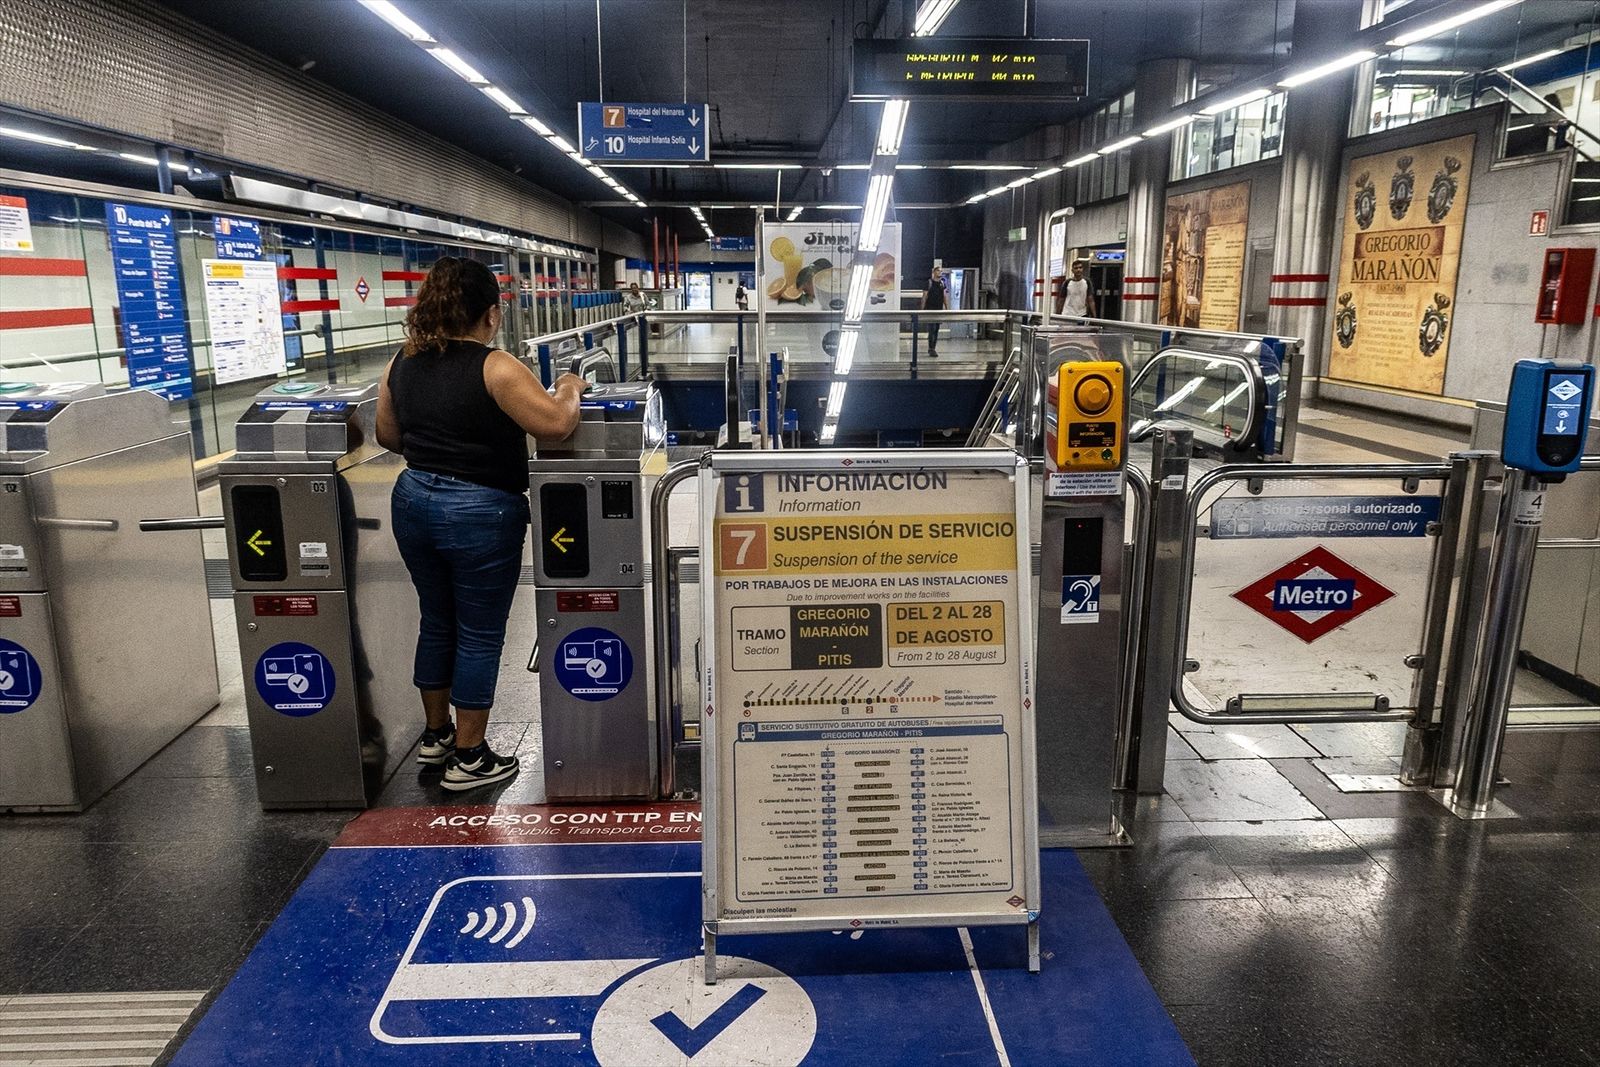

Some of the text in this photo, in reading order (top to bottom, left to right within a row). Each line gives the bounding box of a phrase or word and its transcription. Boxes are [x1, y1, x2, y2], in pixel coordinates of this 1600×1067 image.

[608, 109, 619, 125] 7
[628, 107, 650, 116] Hospital
[606, 137, 624, 154] 10
[628, 136, 650, 144] Hospital
[114, 207, 127, 223] 10
[128, 218, 145, 227] Puerta
[153, 220, 161, 228] Sur
[225, 242, 232, 255] 10
[1365, 233, 1430, 253] GREGORIO
[1351, 252, 1439, 280] MARAÑÓN
[314, 482, 326, 493] 03
[778, 468, 948, 493] INFORMACIÓN
[779, 498, 860, 512] Information
[1532, 495, 1542, 509] 4
[1295, 503, 1350, 517] personal
[1354, 503, 1422, 514] autorizado
[1263, 520, 1417, 533] Authorised personnel only
[730, 520, 1014, 565] 7 SUSPENSIÓN DE SERVICIO
[774, 552, 958, 571] Suspension of the service
[622, 564, 634, 574] 04
[726, 575, 1008, 590] POR TRABAJOS DE MEJORA EN LAS INSTALACIONES
[815, 592, 865, 602] improvement
[867, 591, 888, 599] works
[919, 590, 950, 599] facilities
[1280, 585, 1348, 605] Metro
[896, 606, 992, 620] DEL 2 AL 28
[1089, 602, 1096, 610] T
[797, 608, 870, 621] GREGORIO
[737, 629, 786, 640] TRAMO
[800, 622, 869, 638] MARAÑÓN
[896, 629, 993, 644] DE AGOSTO
[744, 645, 780, 656] Section
[897, 650, 997, 662] From 2 to 28 August
[818, 654, 852, 666] PITIS
[429, 812, 702, 827] ACCESO CON TTP EN
[507, 824, 691, 837] Public Transport Card
